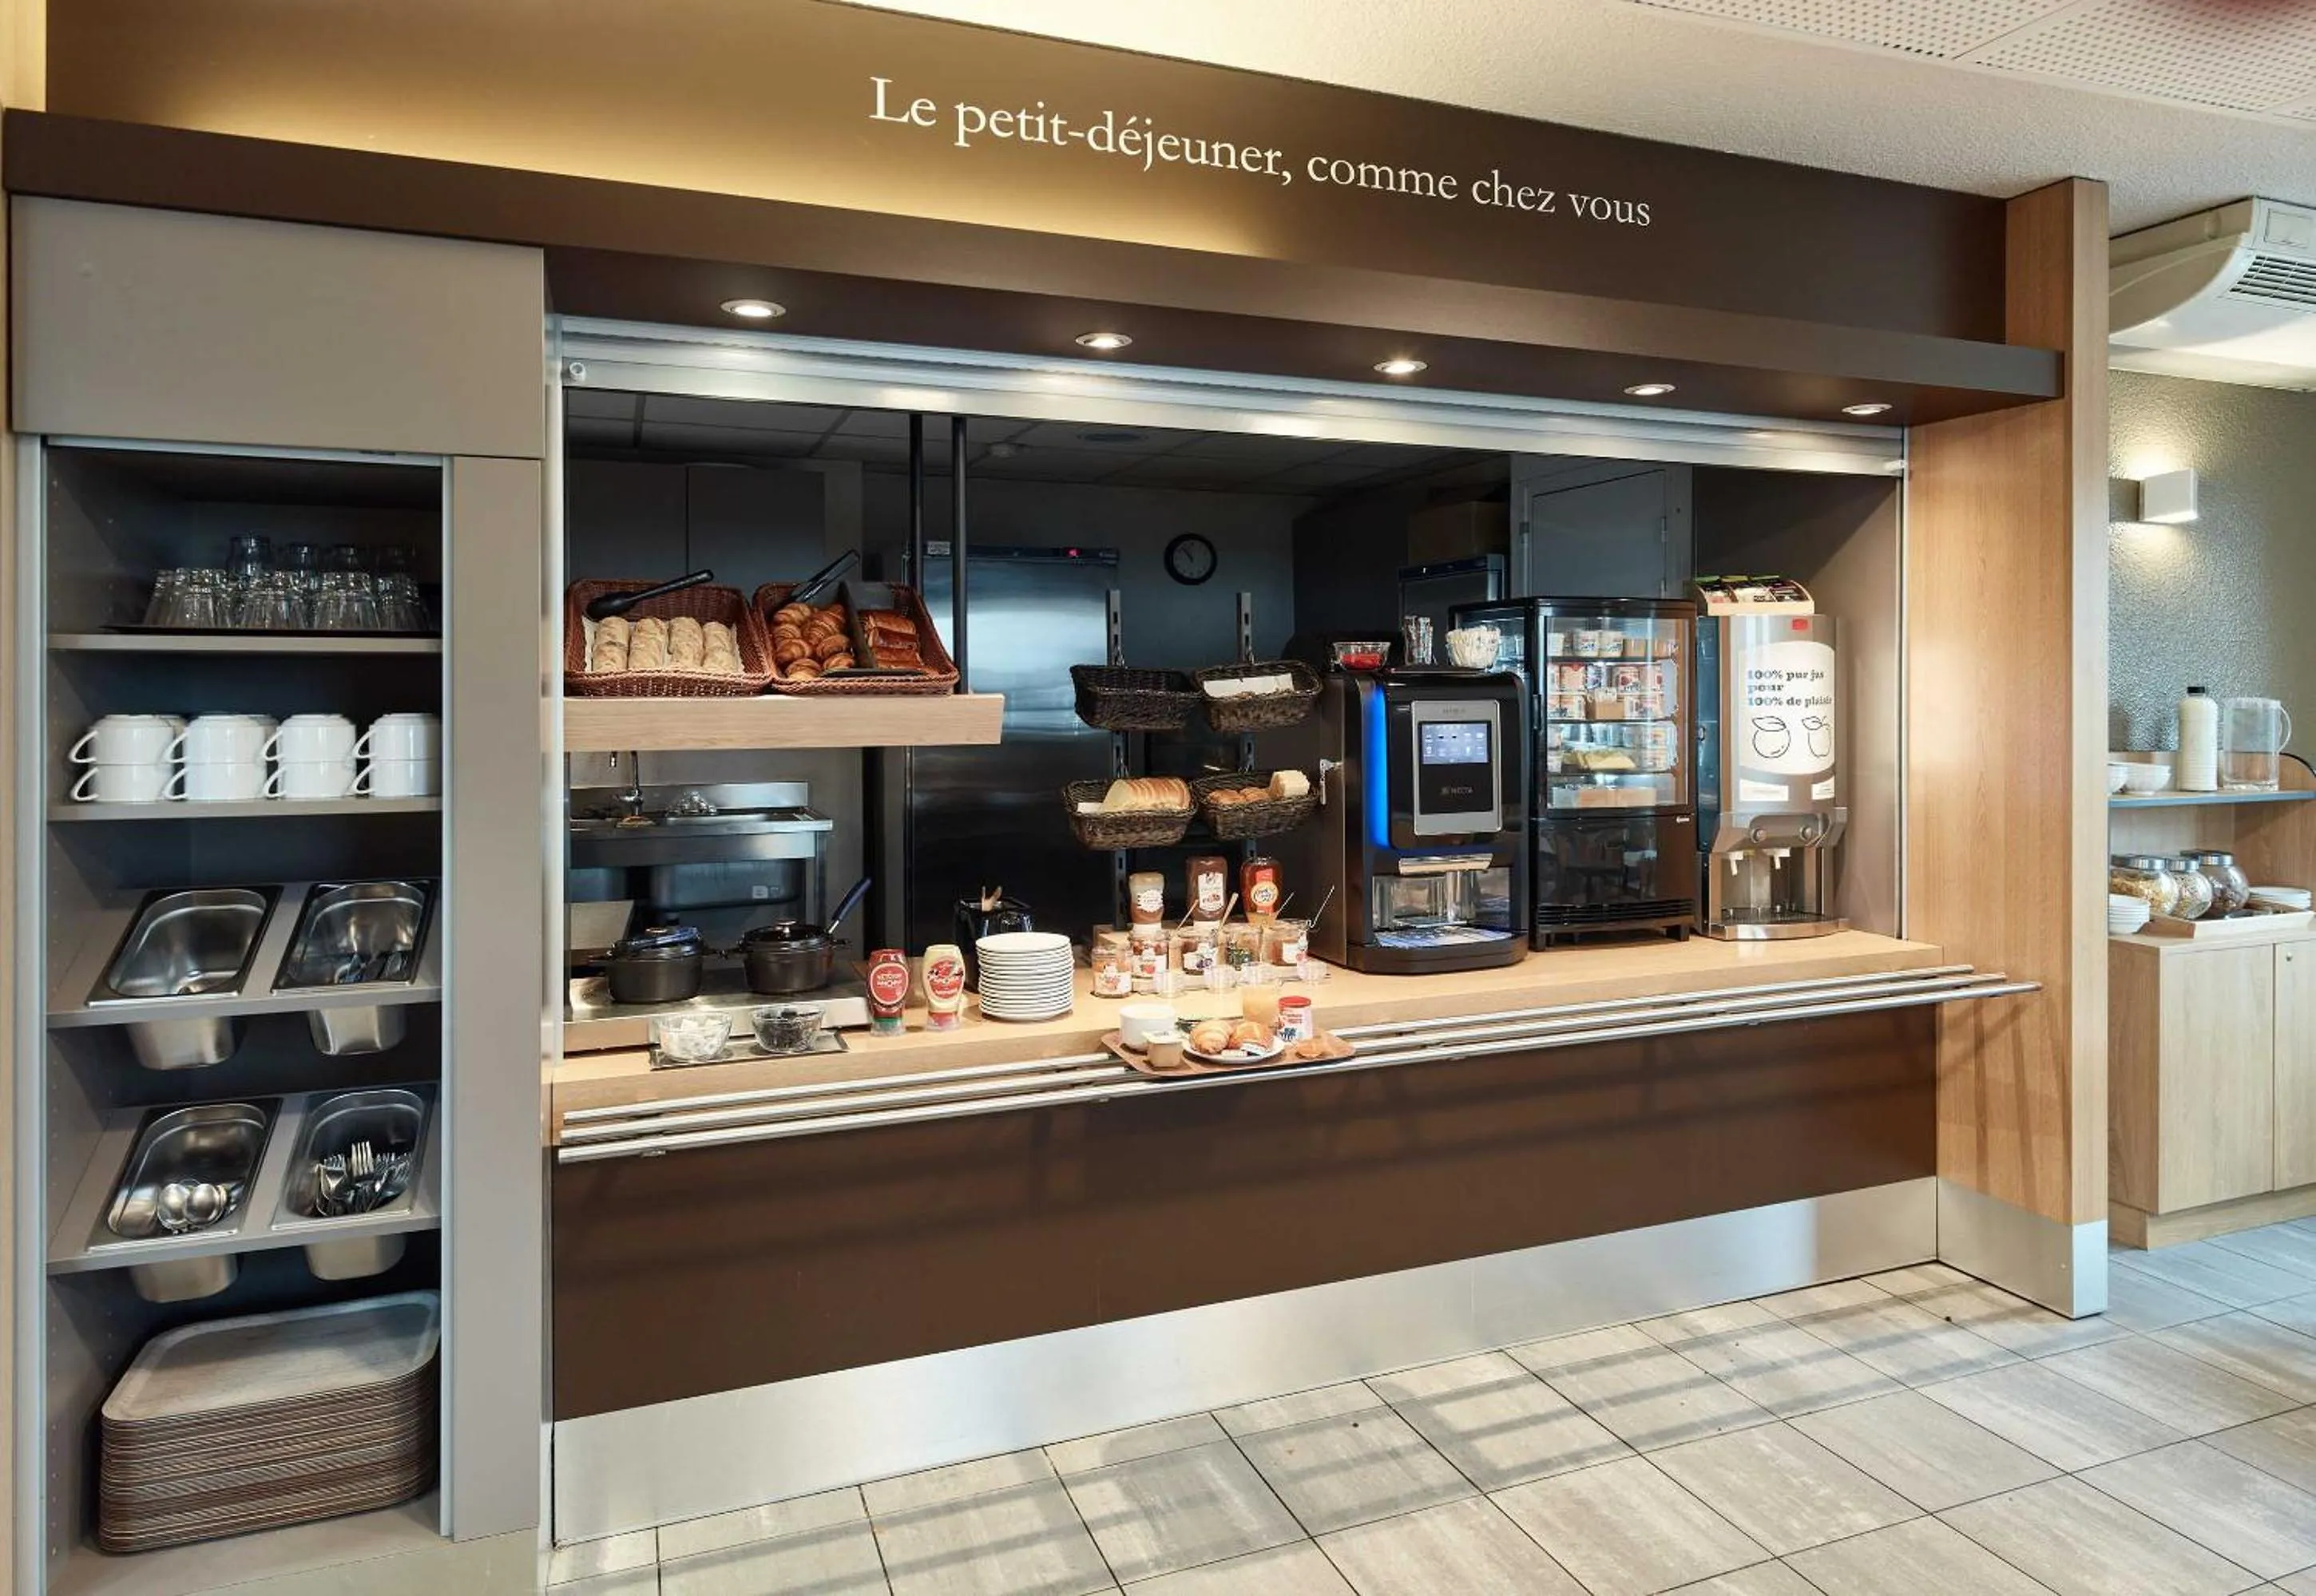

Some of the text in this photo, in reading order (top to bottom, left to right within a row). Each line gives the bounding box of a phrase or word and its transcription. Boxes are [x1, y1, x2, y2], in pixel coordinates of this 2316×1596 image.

[869, 76, 1651, 226] Le petit-déjeuner, comme chez vous
[1747, 669, 1783, 679] 100%
[1786, 671, 1808, 681] pur
[1747, 696, 1783, 706] 100%
[1786, 696, 1802, 706] de
